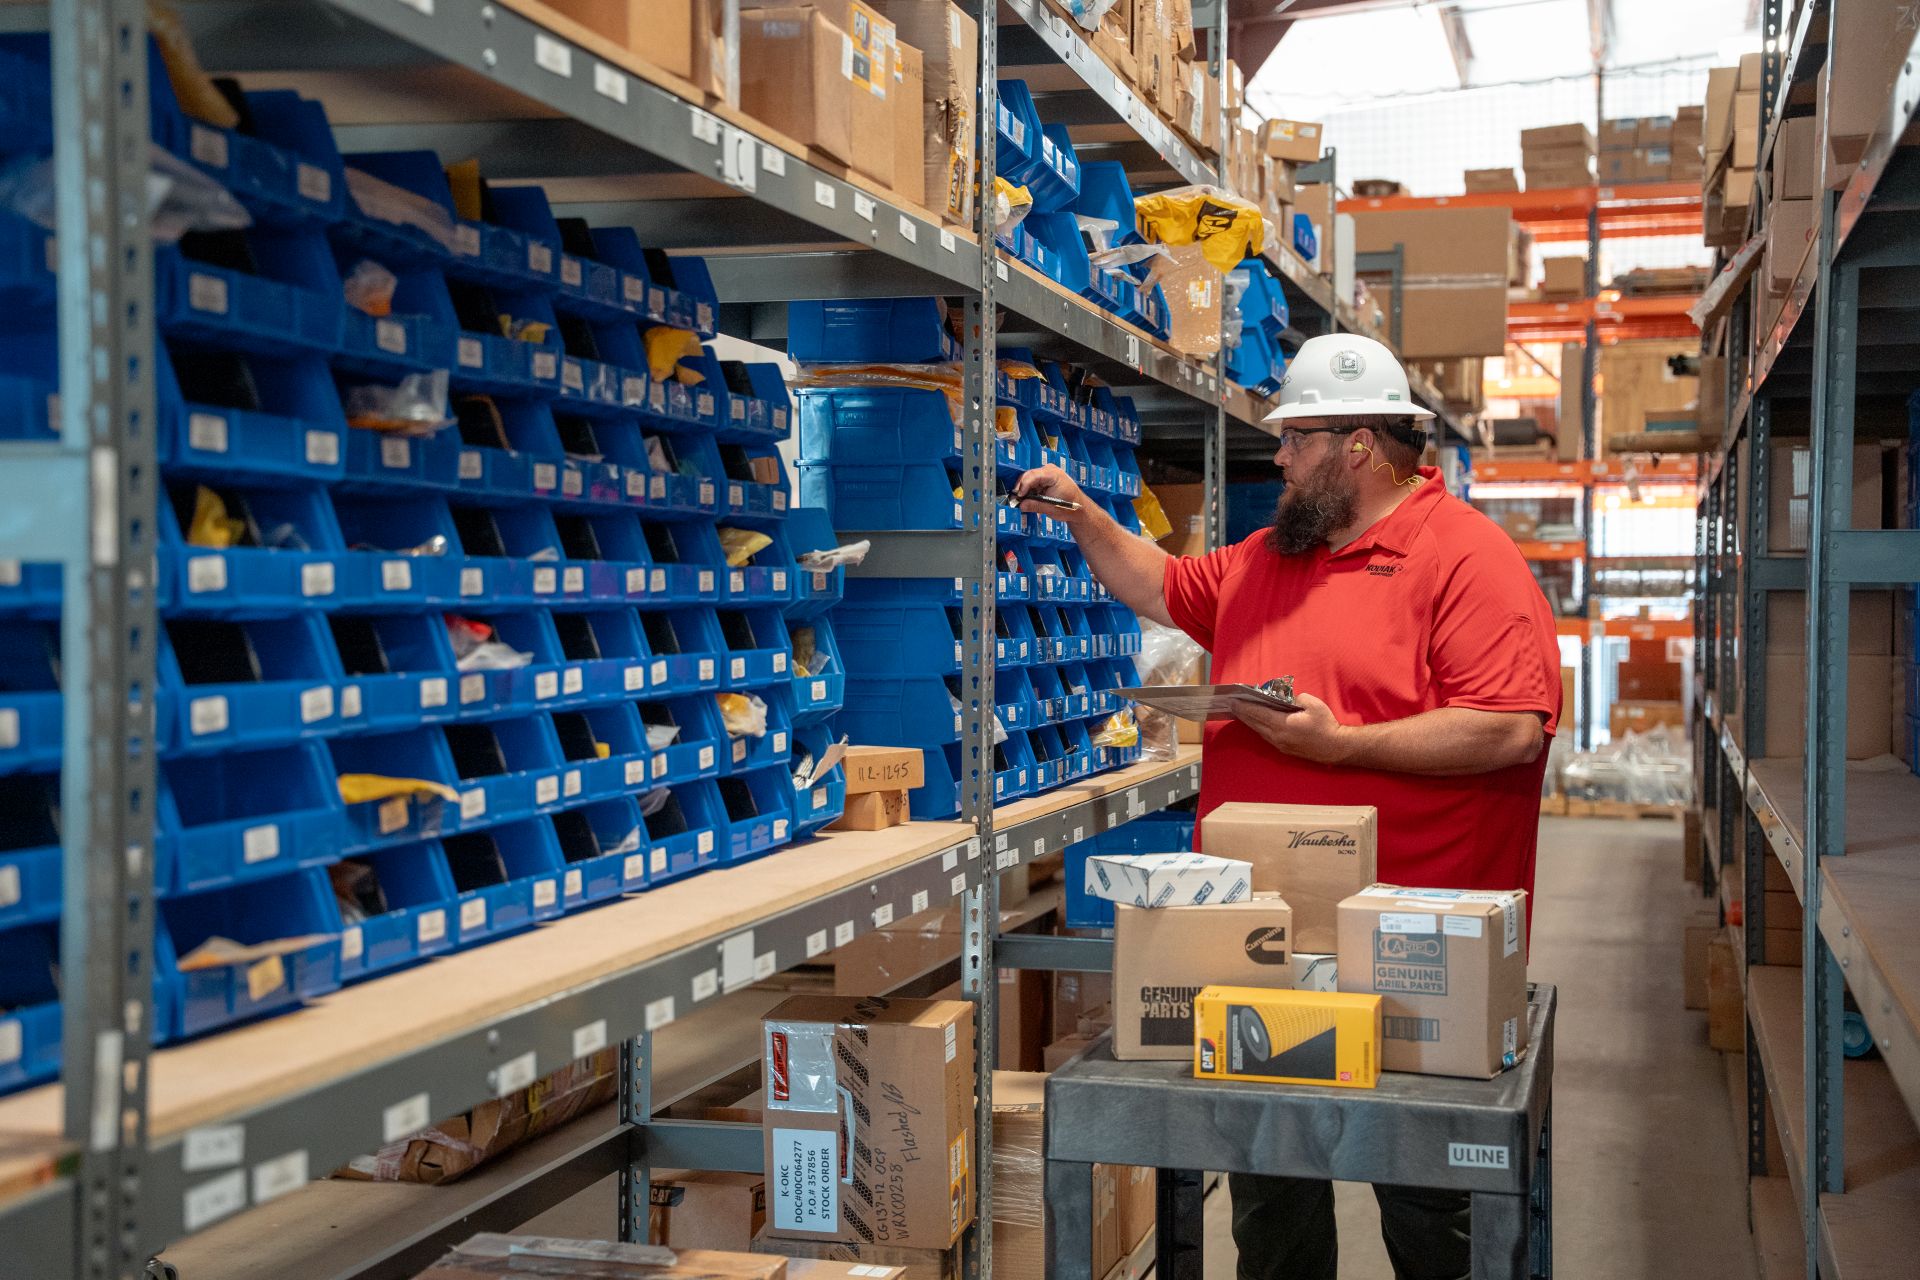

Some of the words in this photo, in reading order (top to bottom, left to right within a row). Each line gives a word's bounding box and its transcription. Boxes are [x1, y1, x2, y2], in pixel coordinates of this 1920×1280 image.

[1365, 563, 1396, 574] KODIAK
[1287, 829, 1357, 849] Waukesha
[1245, 927, 1283, 952] Cummins
[1392, 939, 1434, 954] ARIEL
[1377, 966, 1444, 982] GENUINE
[1140, 986, 1204, 1003] GENUIN
[1377, 979, 1407, 989] ARIEL
[1409, 981, 1444, 991] PARTS
[1141, 1002, 1190, 1019] PARTS
[1202, 1049, 1214, 1069] CAT
[887, 1111, 921, 1163] Flashed
[821, 1148, 830, 1183] ORDER
[1453, 1146, 1505, 1165] ULINE
[808, 1150, 816, 1186] 357856
[780, 1165, 790, 1197] K-OKC
[794, 1141, 803, 1223] DOC#00C064277
[650, 1188, 672, 1203] CAT
[808, 1189, 817, 1216] P.O.#
[821, 1186, 830, 1220] STOCK
